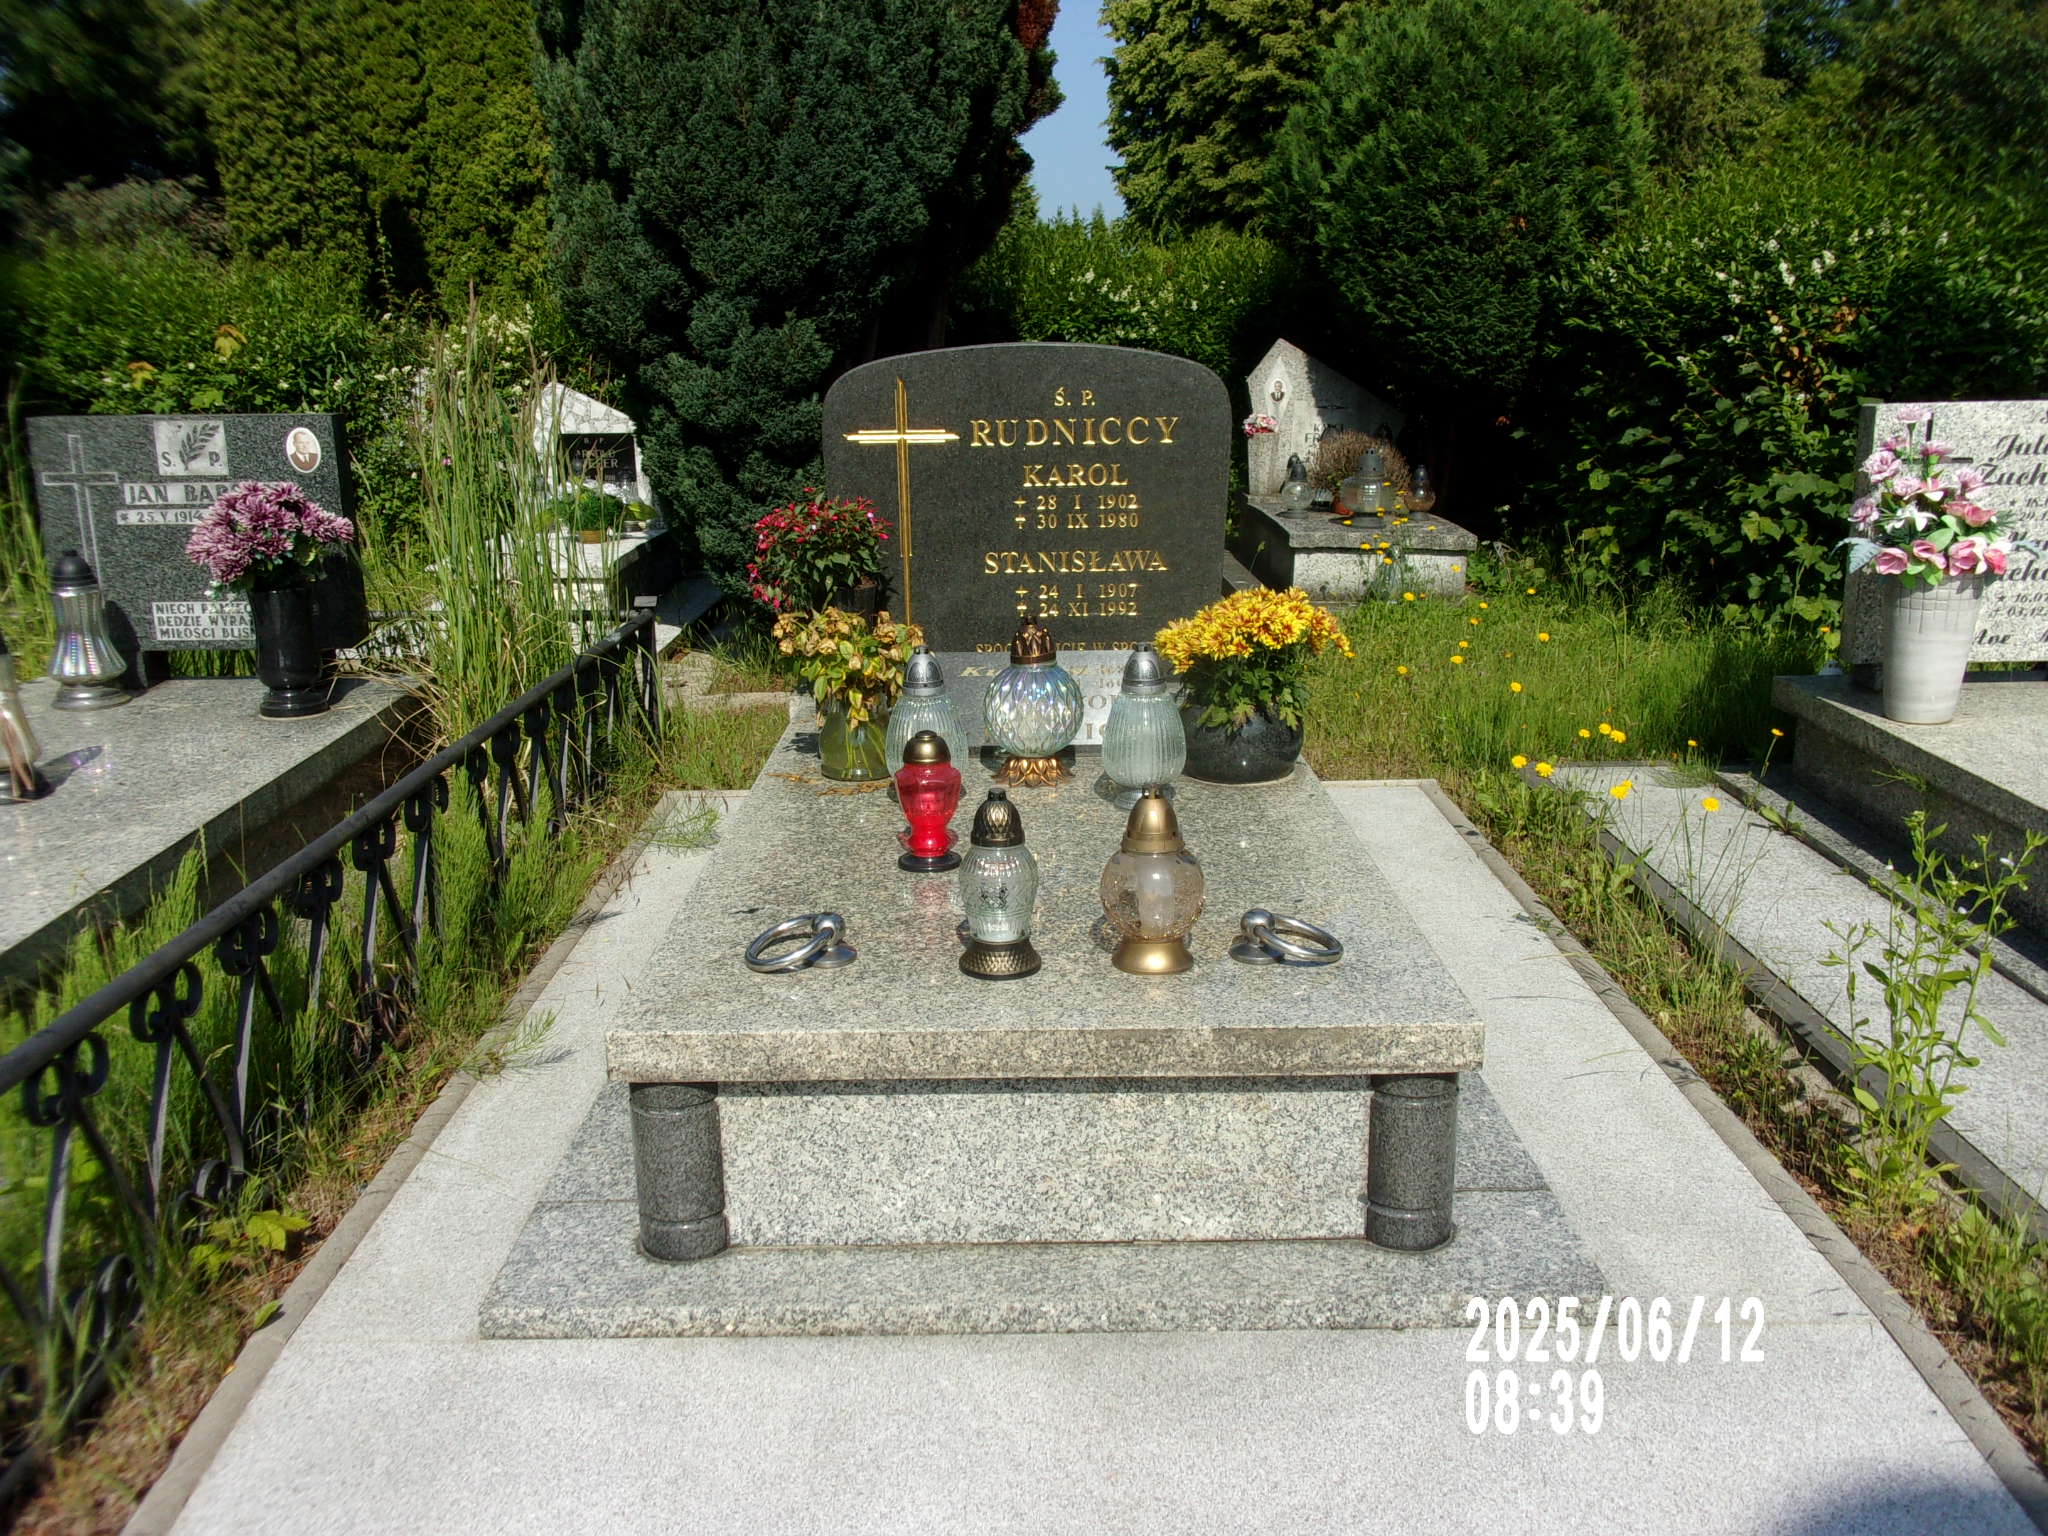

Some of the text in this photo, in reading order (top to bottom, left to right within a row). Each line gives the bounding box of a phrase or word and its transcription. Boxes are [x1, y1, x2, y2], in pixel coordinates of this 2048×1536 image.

[1054, 386, 1096, 407] Ś. P.
[969, 415, 1180, 448] RUDNICCY
[1022, 463, 1129, 488] KAROL
[128, 484, 170, 505] JAN
[1036, 494, 1139, 510] 28 I 1902
[1037, 513, 1139, 529] 30 IX 1980
[983, 549, 1169, 575] STANISŁAWA
[1038, 583, 1138, 600] 24 I 1907
[155, 603, 195, 615] NIECH
[1039, 602, 1138, 618] 24 XI 1992
